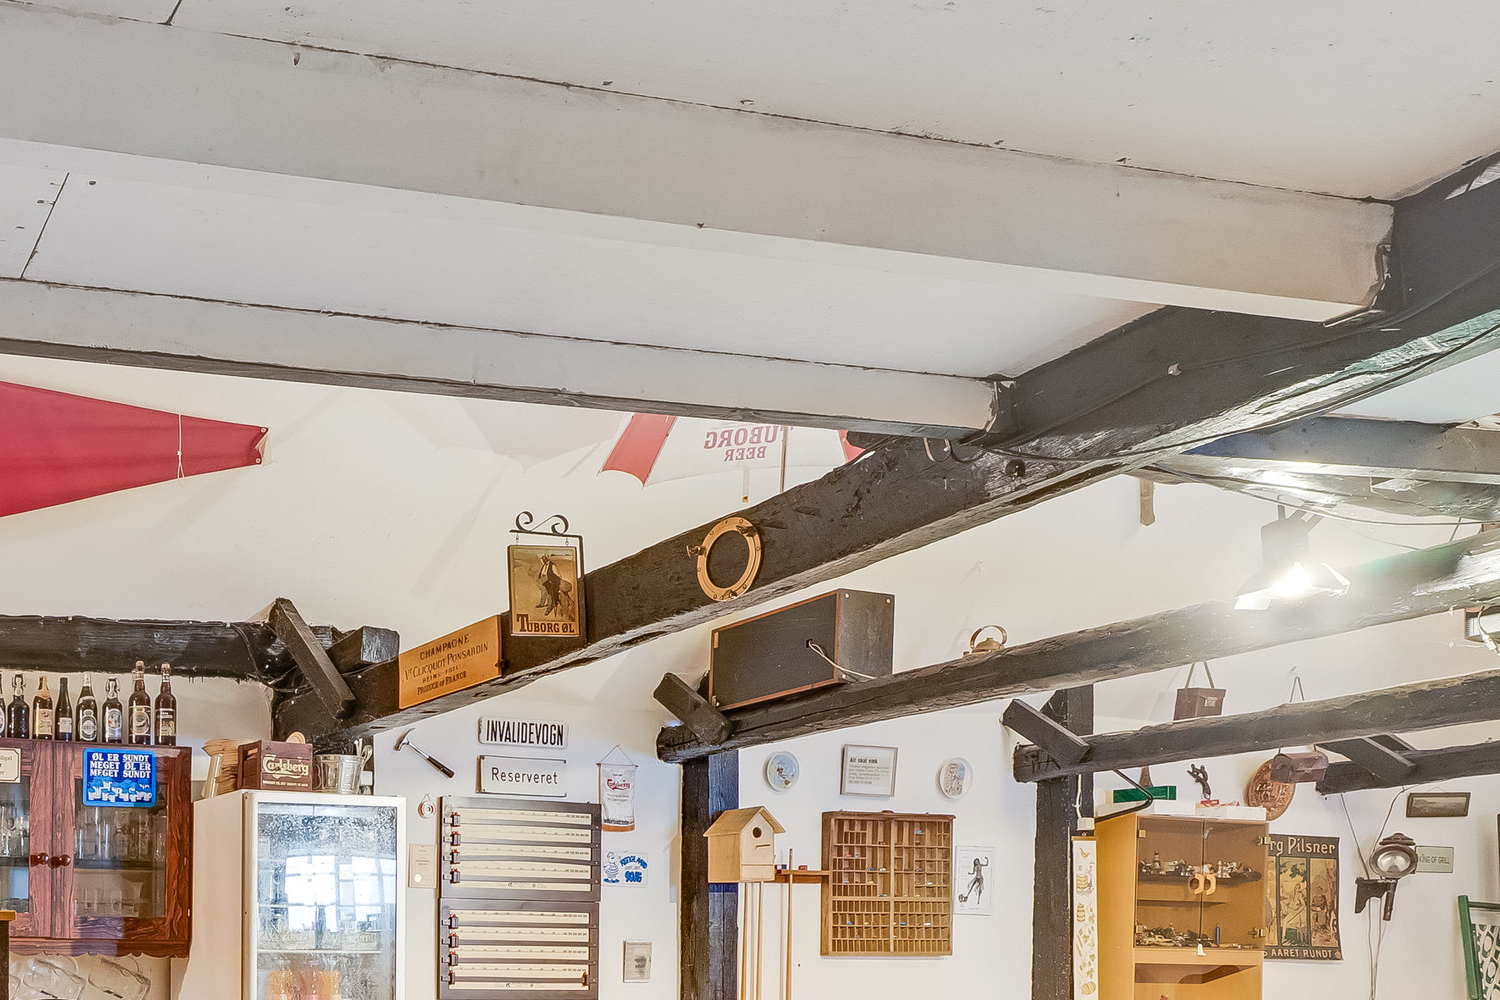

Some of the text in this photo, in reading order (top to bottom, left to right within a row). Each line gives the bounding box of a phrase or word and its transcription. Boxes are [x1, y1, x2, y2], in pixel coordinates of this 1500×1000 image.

[517, 613, 575, 633] TUBORG ØL
[419, 633, 470, 660] CHAMPAGNE
[445, 671, 467, 685] FRANCE
[486, 719, 564, 746] INVALIDEVOGN
[90, 761, 151, 771] MEGET ØL ER
[92, 753, 149, 762] ØL ER SUNDT
[263, 753, 309, 776] Carlsberg
[90, 769, 151, 779] MEGET SUNDT
[491, 767, 558, 785] Reserveret
[1287, 836, 1336, 855] Pilsner
[1271, 948, 1299, 958] AARET
[1303, 949, 1332, 959] RUNDT
